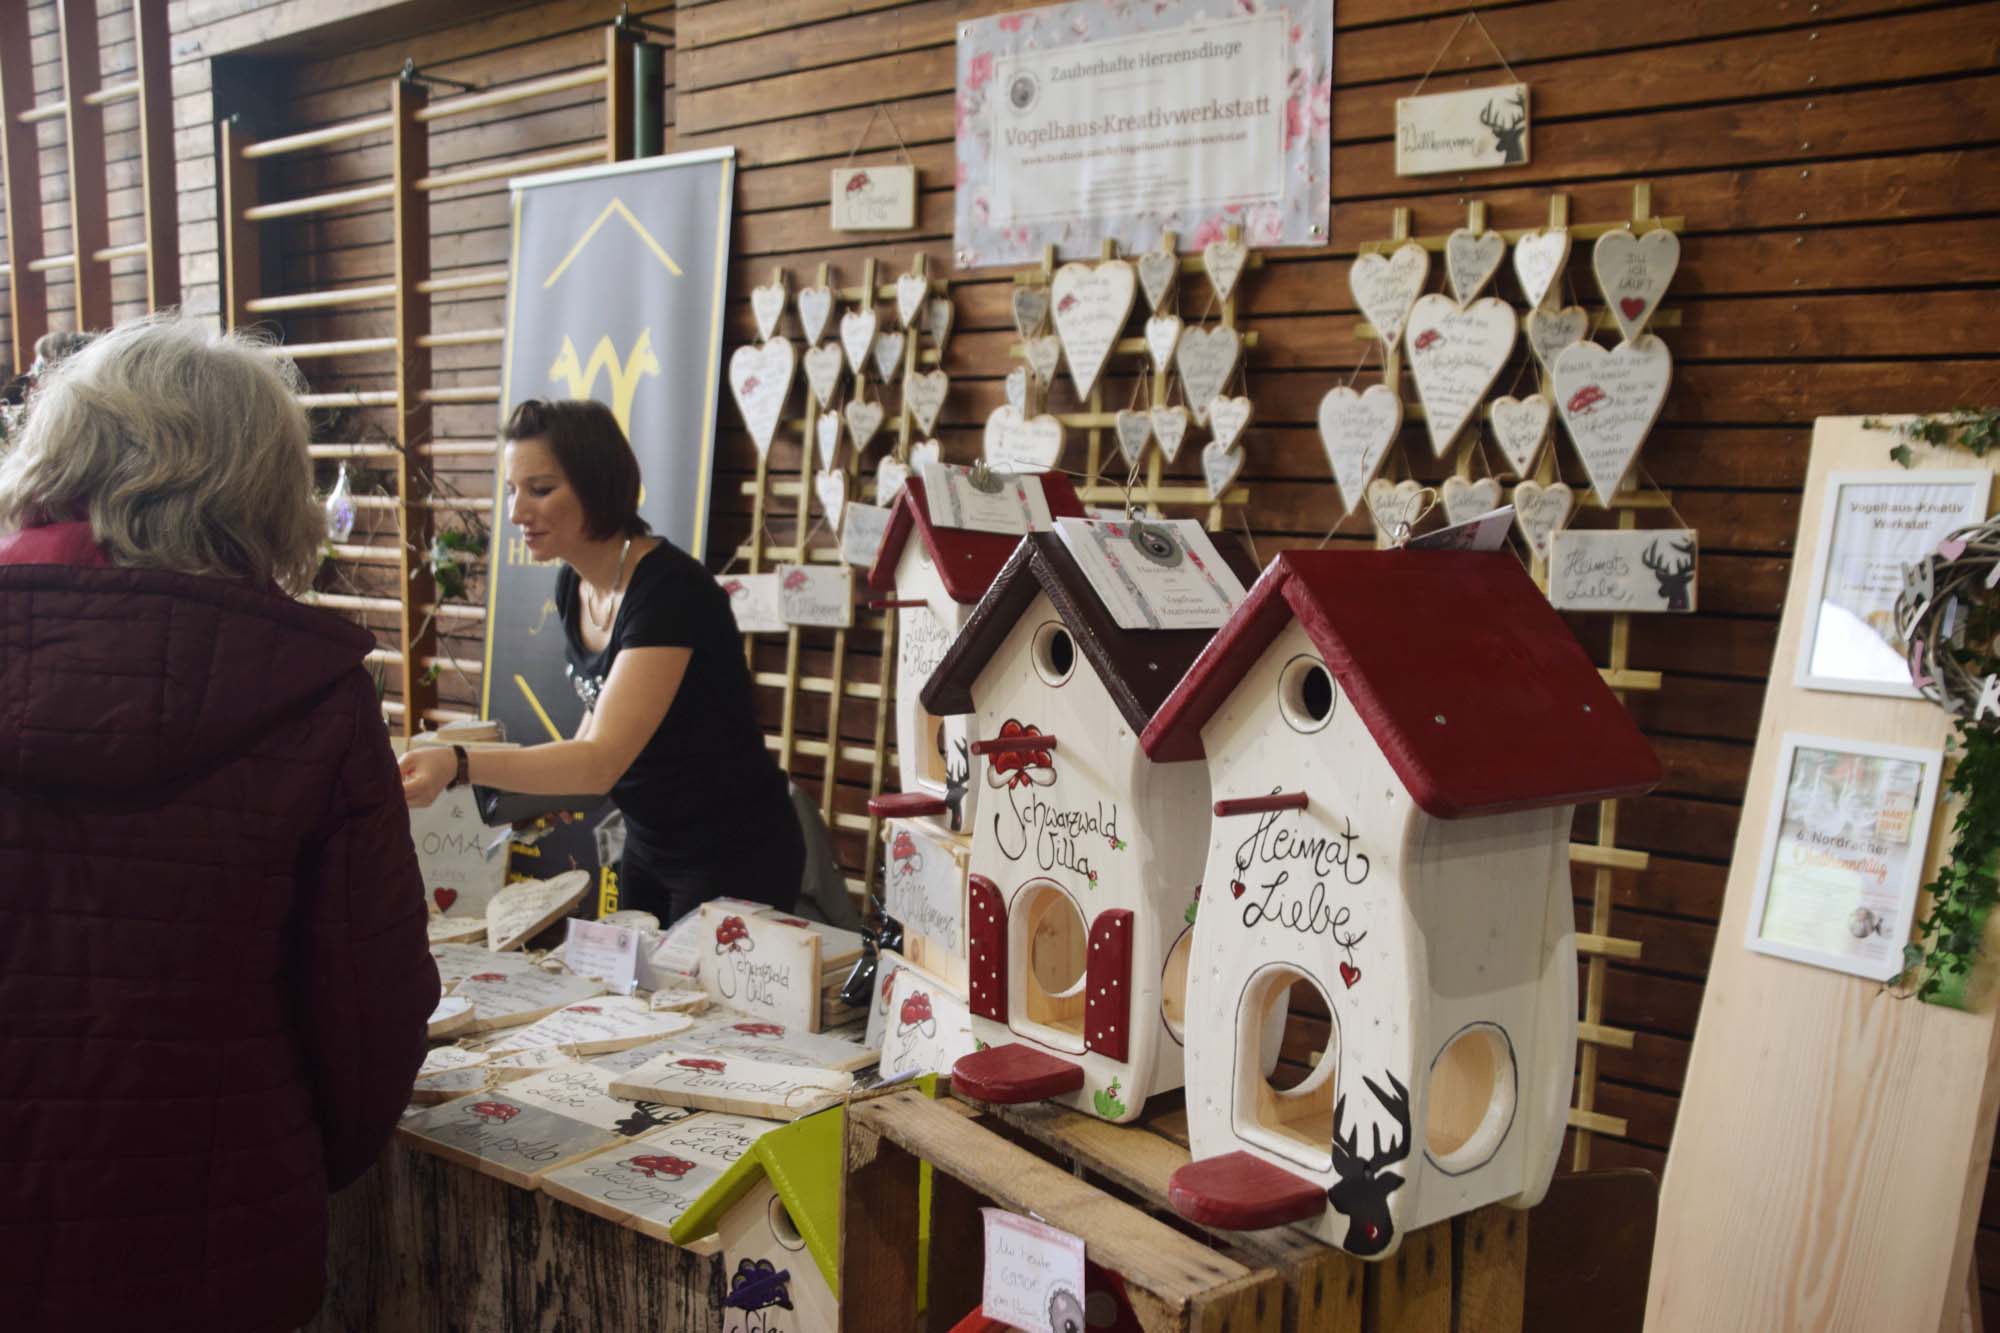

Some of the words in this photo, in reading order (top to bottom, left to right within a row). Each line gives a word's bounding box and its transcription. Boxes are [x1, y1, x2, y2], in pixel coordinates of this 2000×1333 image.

[1050, 53, 1137, 83] Zauberhafte
[1139, 39, 1243, 76] Herzensdinge
[1005, 95, 1271, 150] Vogelhaus-Kreativwerkstatt
[422, 831, 485, 860] OMA
[993, 788, 1120, 861] Schwarzwald
[1236, 786, 1370, 885] Heimat
[1036, 831, 1091, 876] Villa
[1242, 870, 1368, 947] Liebe
